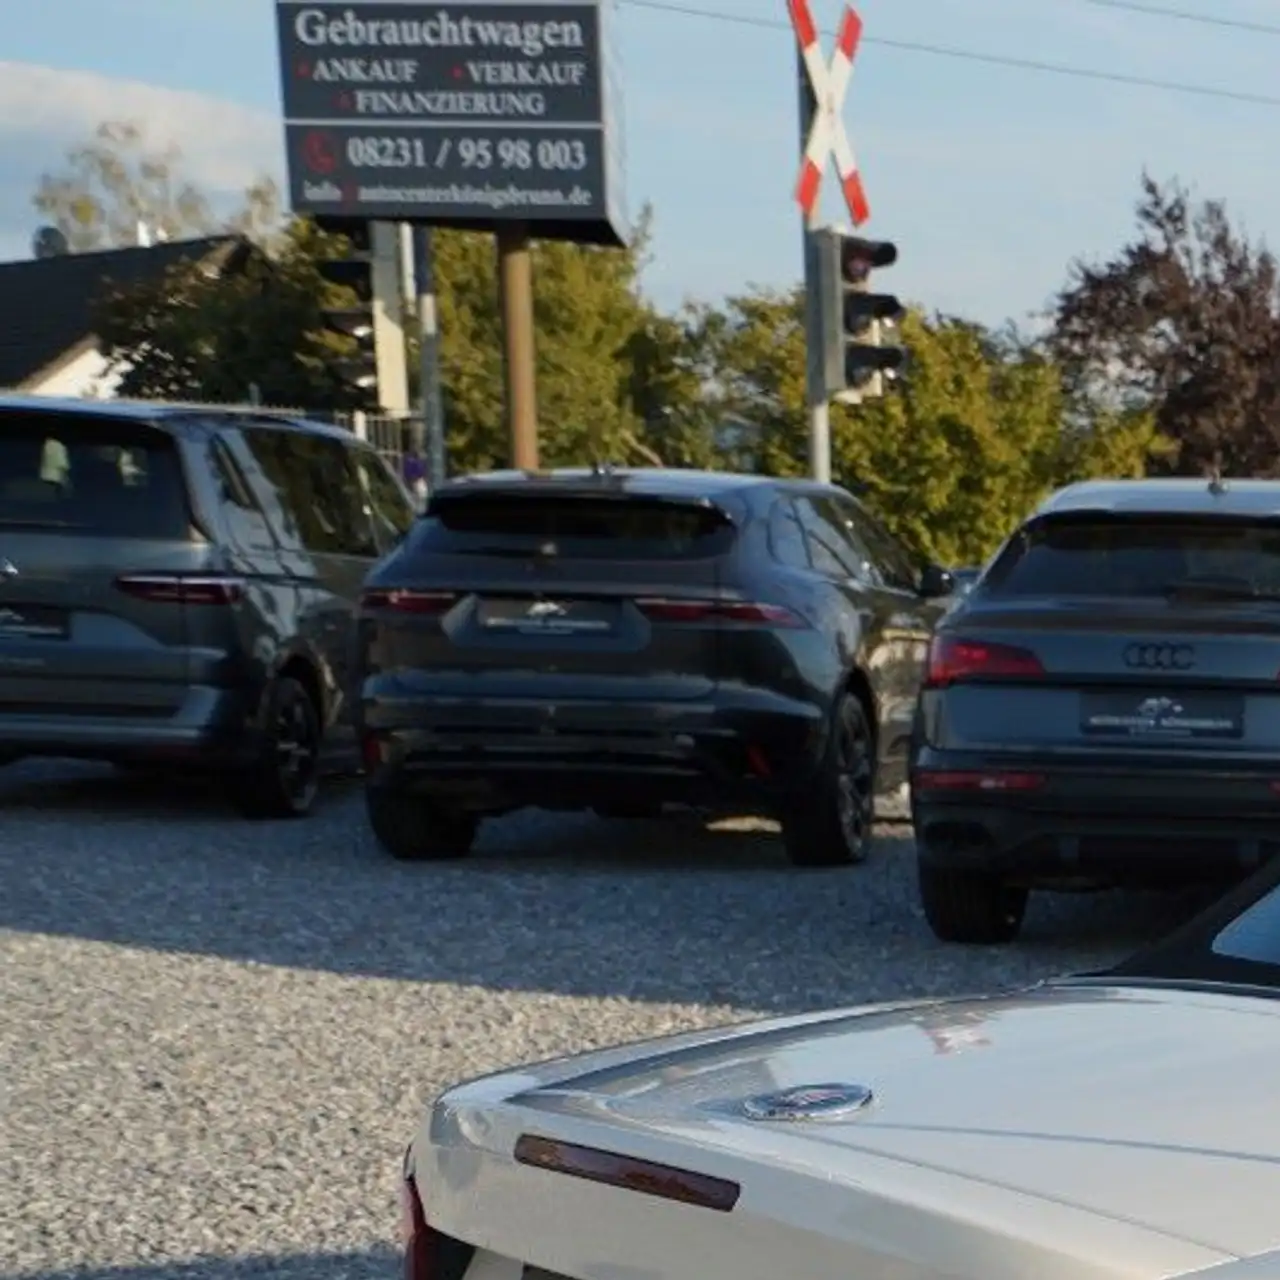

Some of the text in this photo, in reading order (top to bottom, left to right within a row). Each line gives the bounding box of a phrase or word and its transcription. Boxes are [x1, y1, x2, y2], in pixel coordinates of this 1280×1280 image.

[295, 9, 583, 56] Gebrauchtwagen
[312, 59, 587, 86] ANKAUF VERKAUF
[355, 89, 546, 116] FINANZIERUNG
[347, 138, 587, 171] 08231 / 95 98 003
